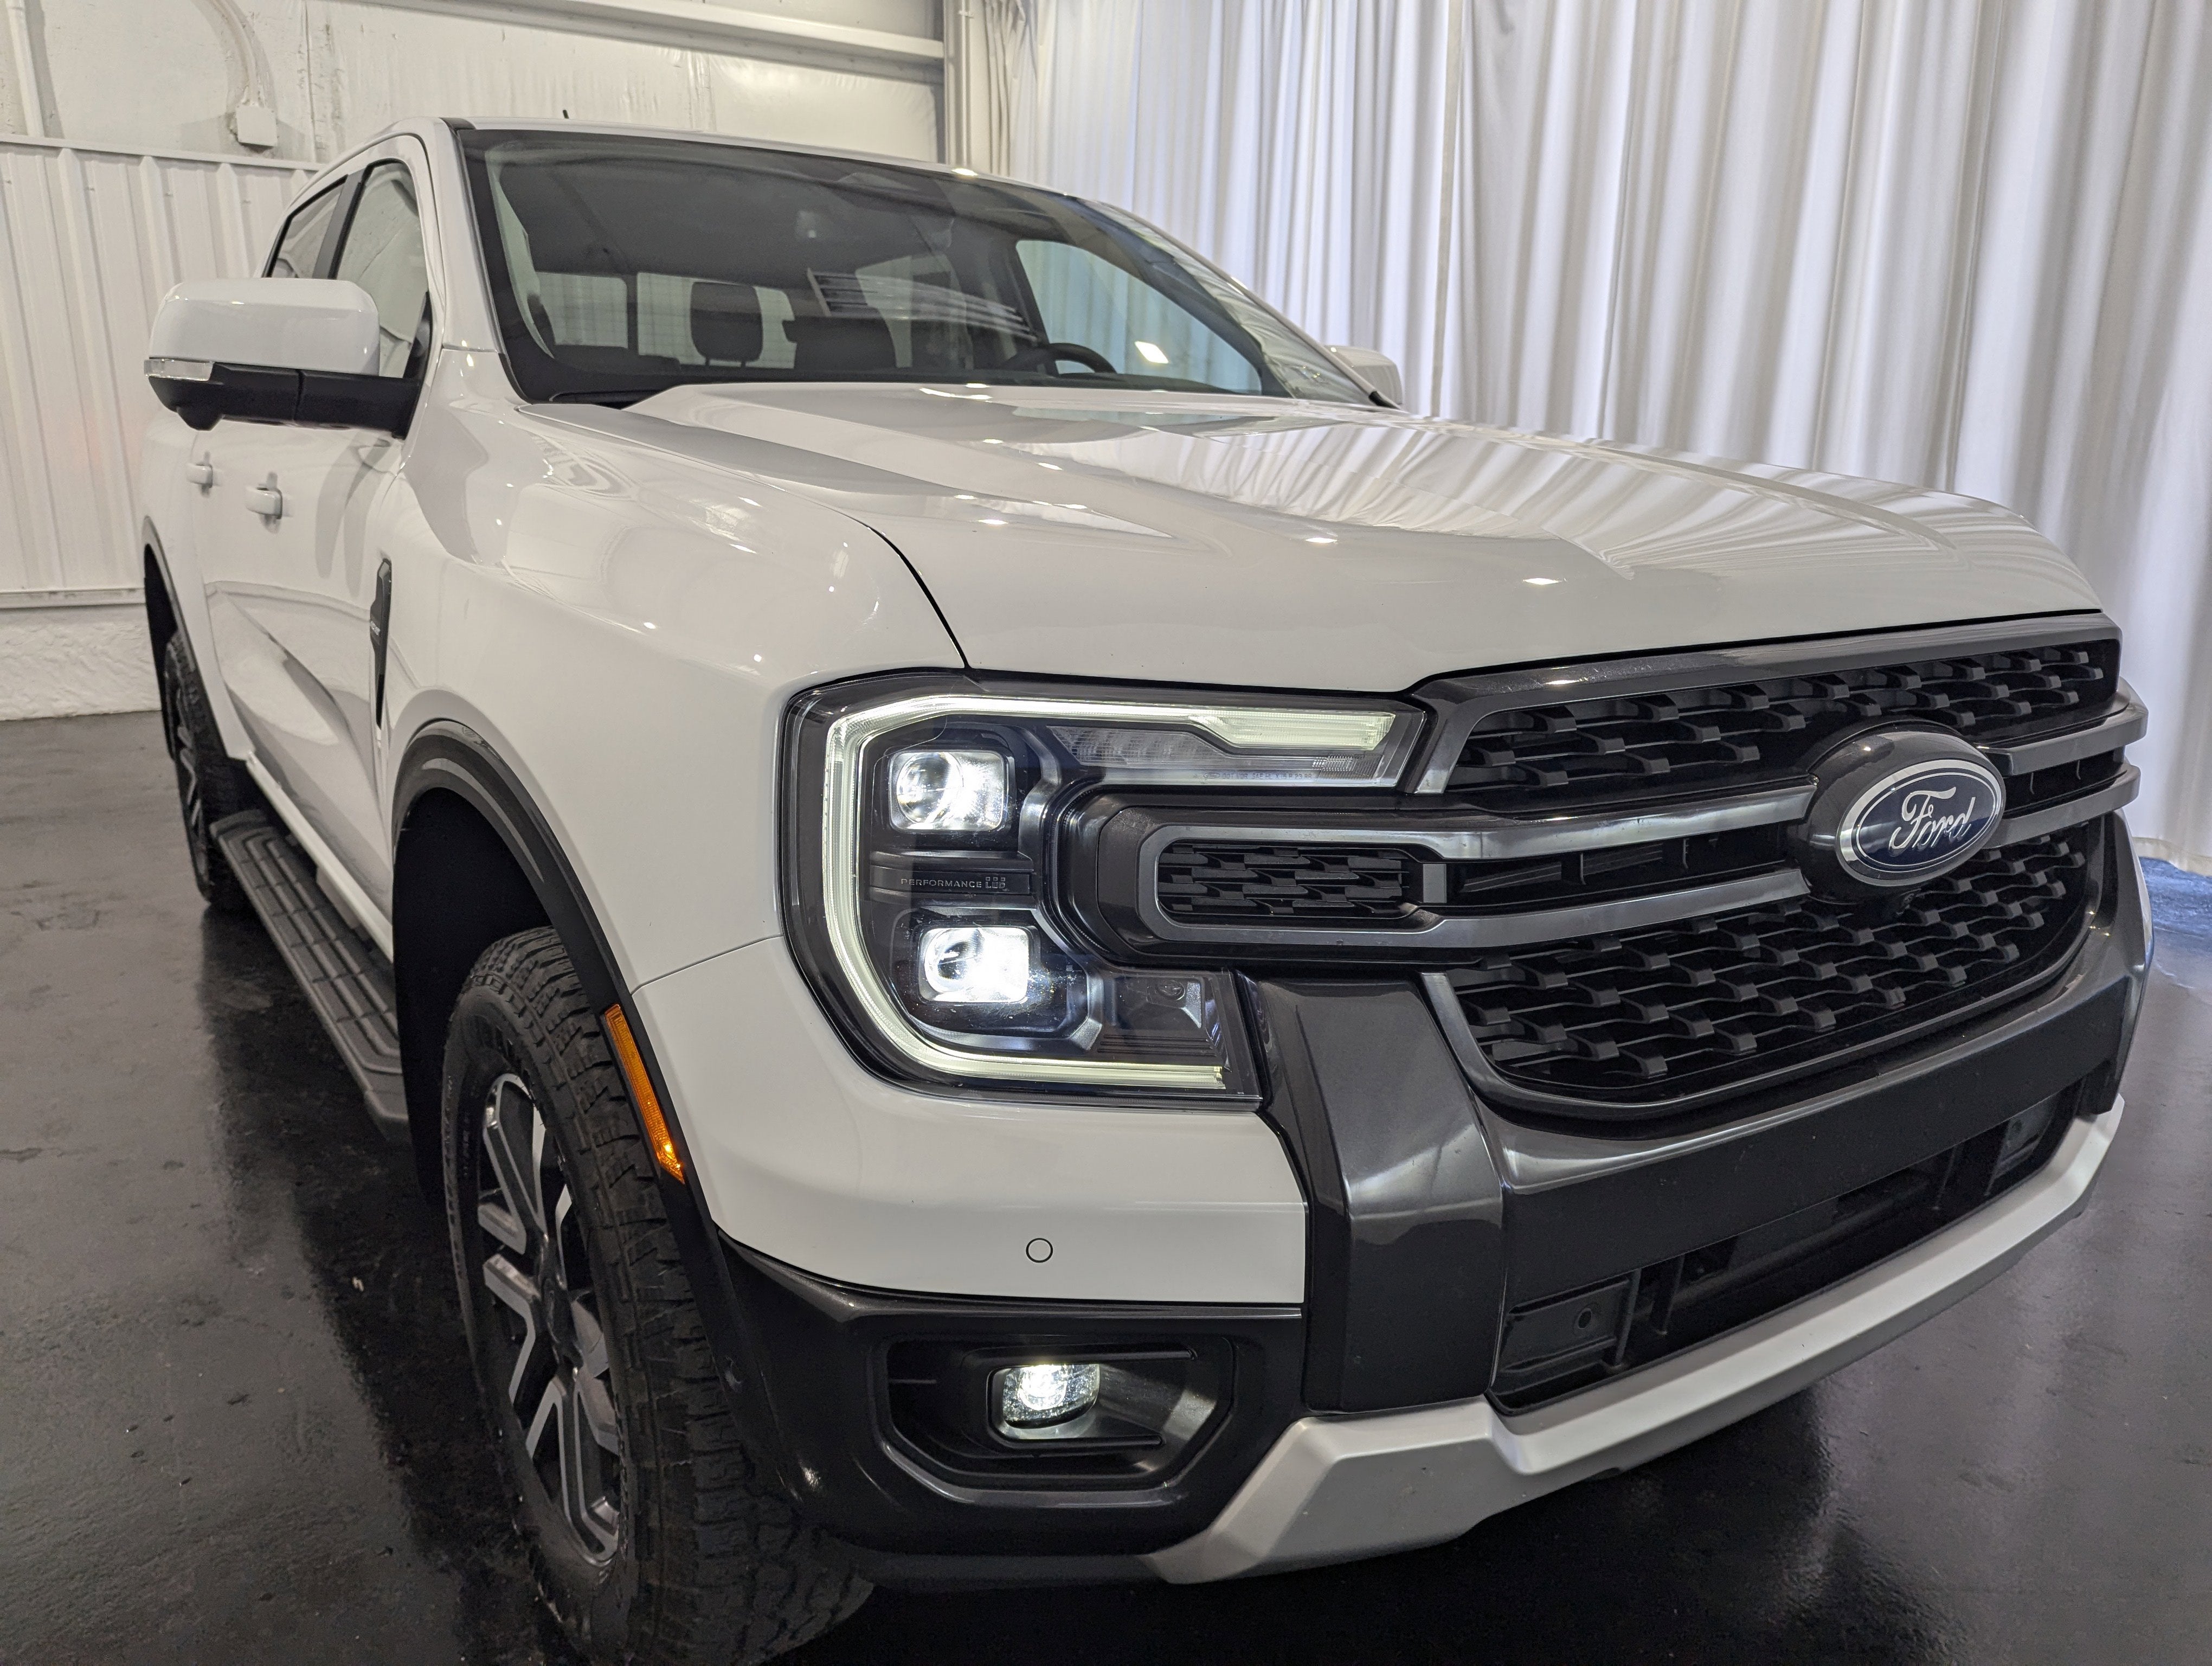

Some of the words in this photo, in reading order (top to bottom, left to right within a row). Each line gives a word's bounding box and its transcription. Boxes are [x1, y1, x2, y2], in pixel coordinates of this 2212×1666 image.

[1888, 786, 1976, 853] Ford
[901, 878, 982, 888] PERFORMANCE
[985, 881, 1006, 889] LED
